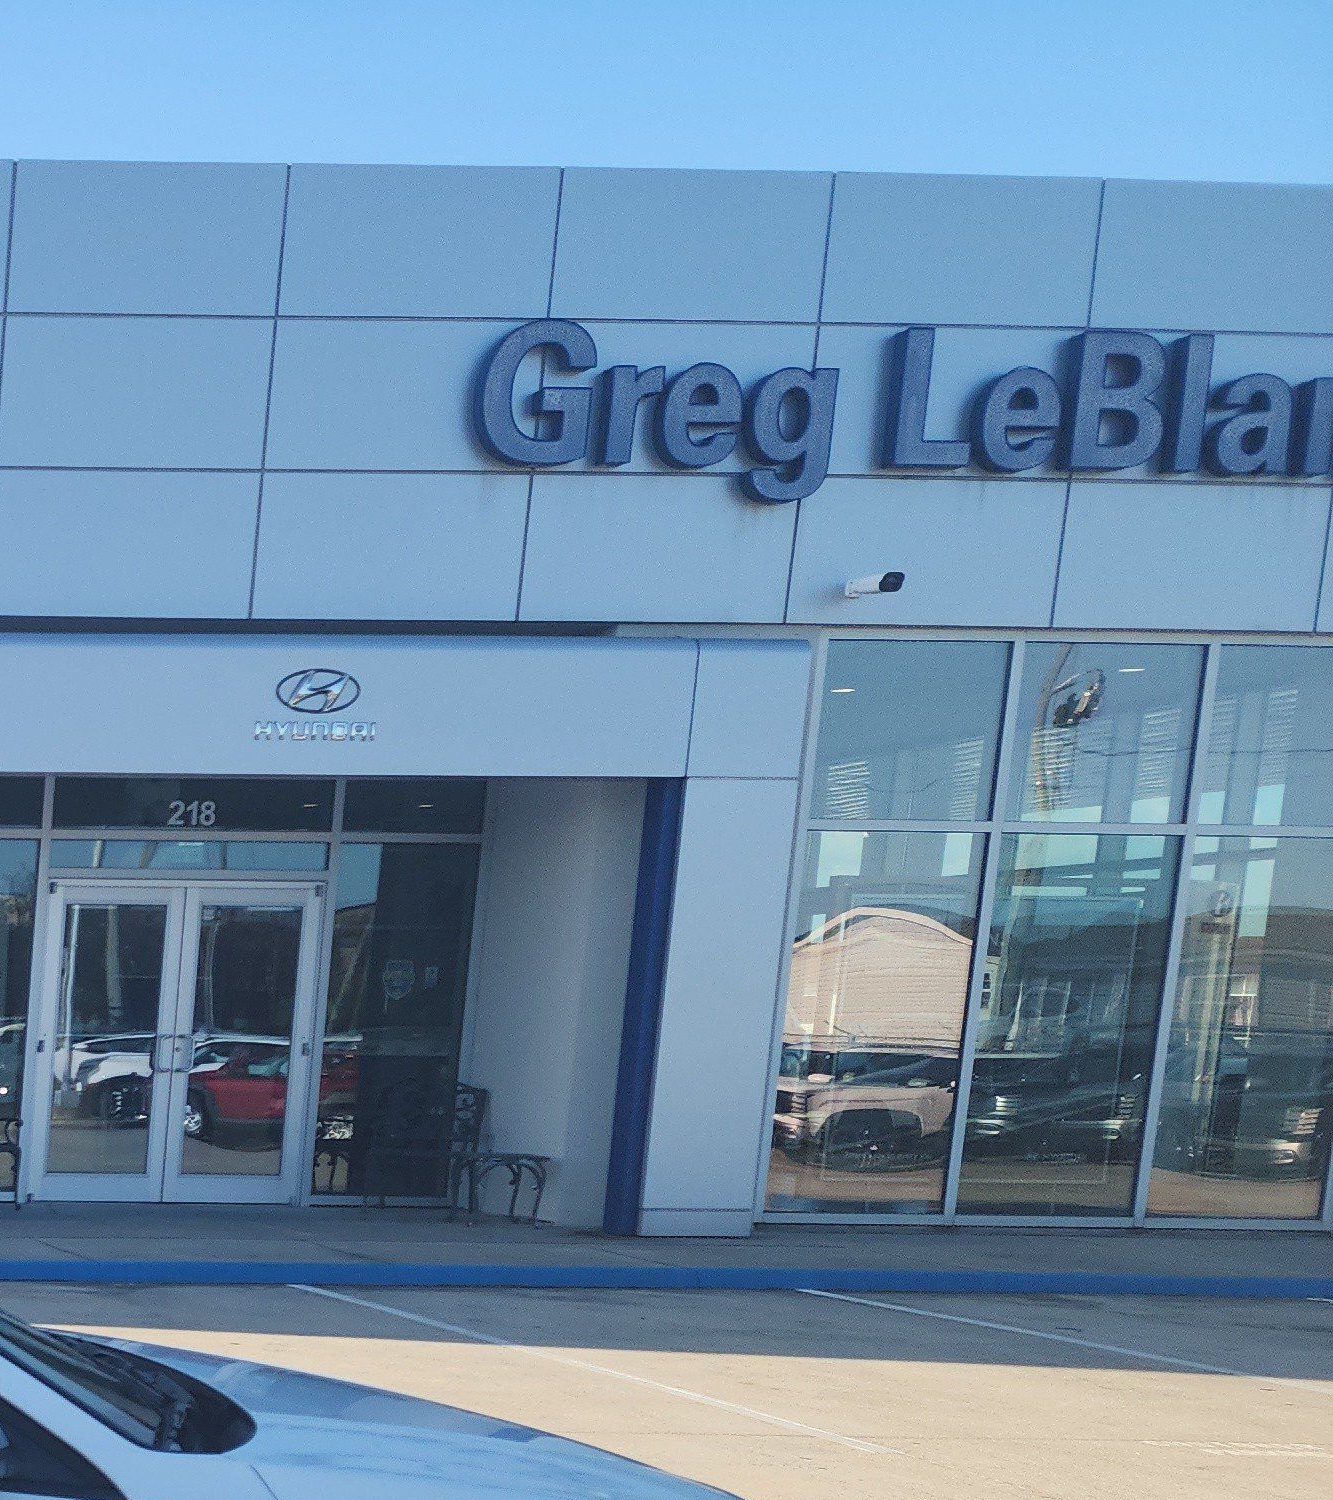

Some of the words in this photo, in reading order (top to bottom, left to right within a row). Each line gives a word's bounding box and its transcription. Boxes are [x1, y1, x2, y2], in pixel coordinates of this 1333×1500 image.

[471, 319, 840, 503] Greg
[253, 720, 376, 741] HYUNDAI
[167, 800, 217, 827] 218
